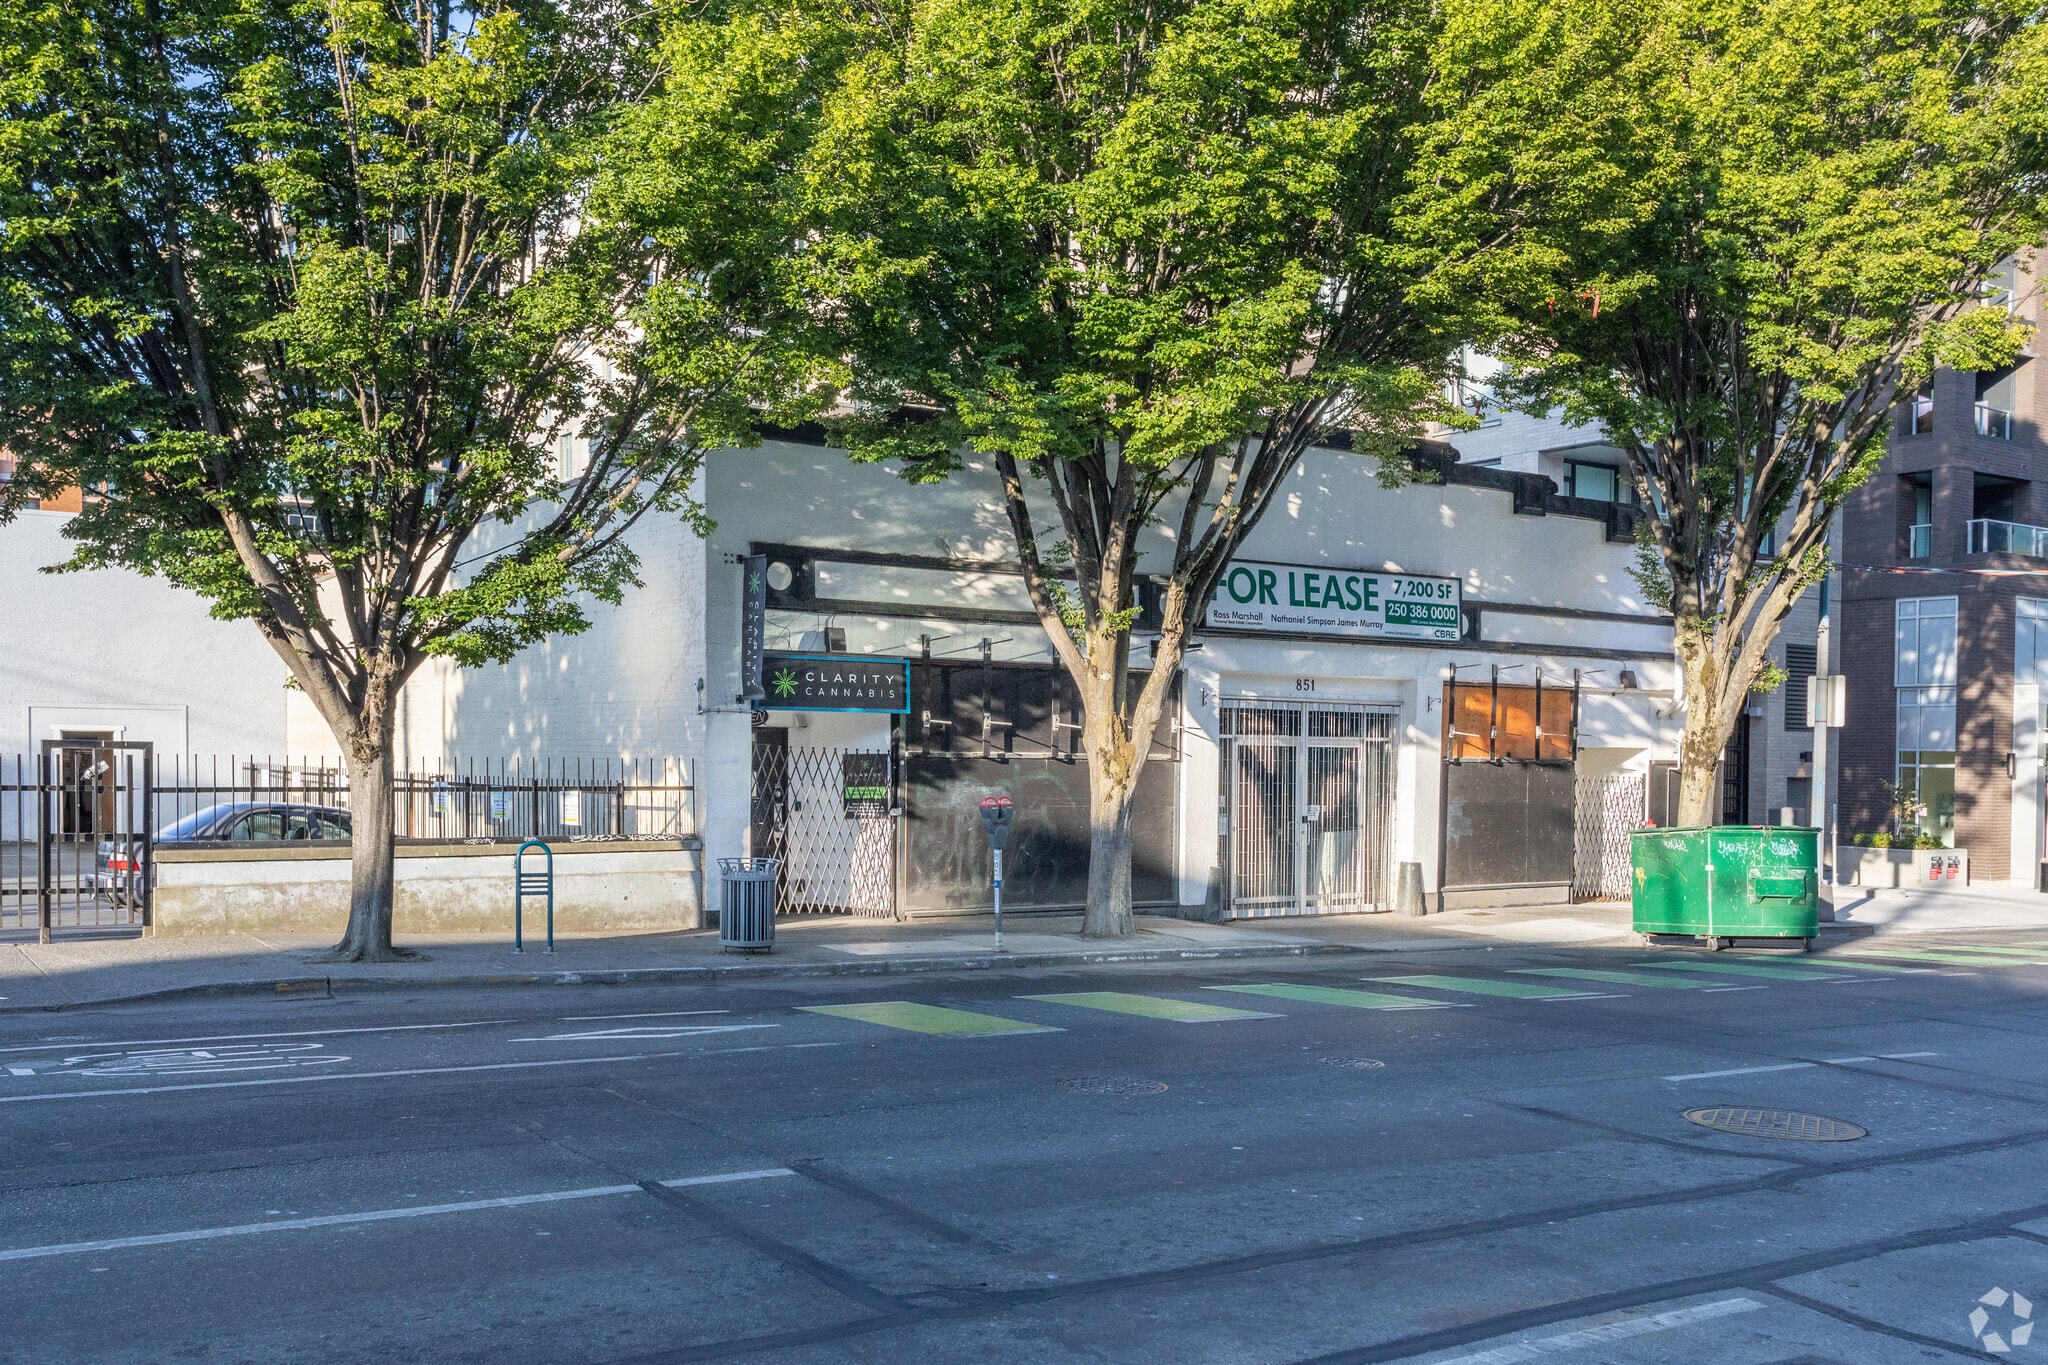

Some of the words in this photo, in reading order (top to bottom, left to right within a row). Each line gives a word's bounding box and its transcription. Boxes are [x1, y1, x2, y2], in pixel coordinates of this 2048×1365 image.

[1288, 572, 1380, 612] LEASE
[1394, 579, 1434, 598] 7,200
[1437, 583, 1452, 599] SF
[1213, 609, 1230, 619] Ross
[1232, 611, 1263, 621] Marshall
[1388, 603, 1407, 616] 250
[1409, 604, 1428, 618] 386
[1430, 606, 1456, 620] 0000
[1271, 614, 1305, 624] Nathaniel
[1307, 616, 1336, 627] Simpson
[1337, 618, 1358, 627] James
[1360, 619, 1384, 630] Murray
[1434, 629, 1457, 639] CBRE
[751, 601, 760, 686] CLARITY
[805, 672, 895, 685] CLARITY
[1296, 678, 1315, 691] 851
[805, 687, 895, 699] CANNABIS
[752, 711, 766, 721] EN
